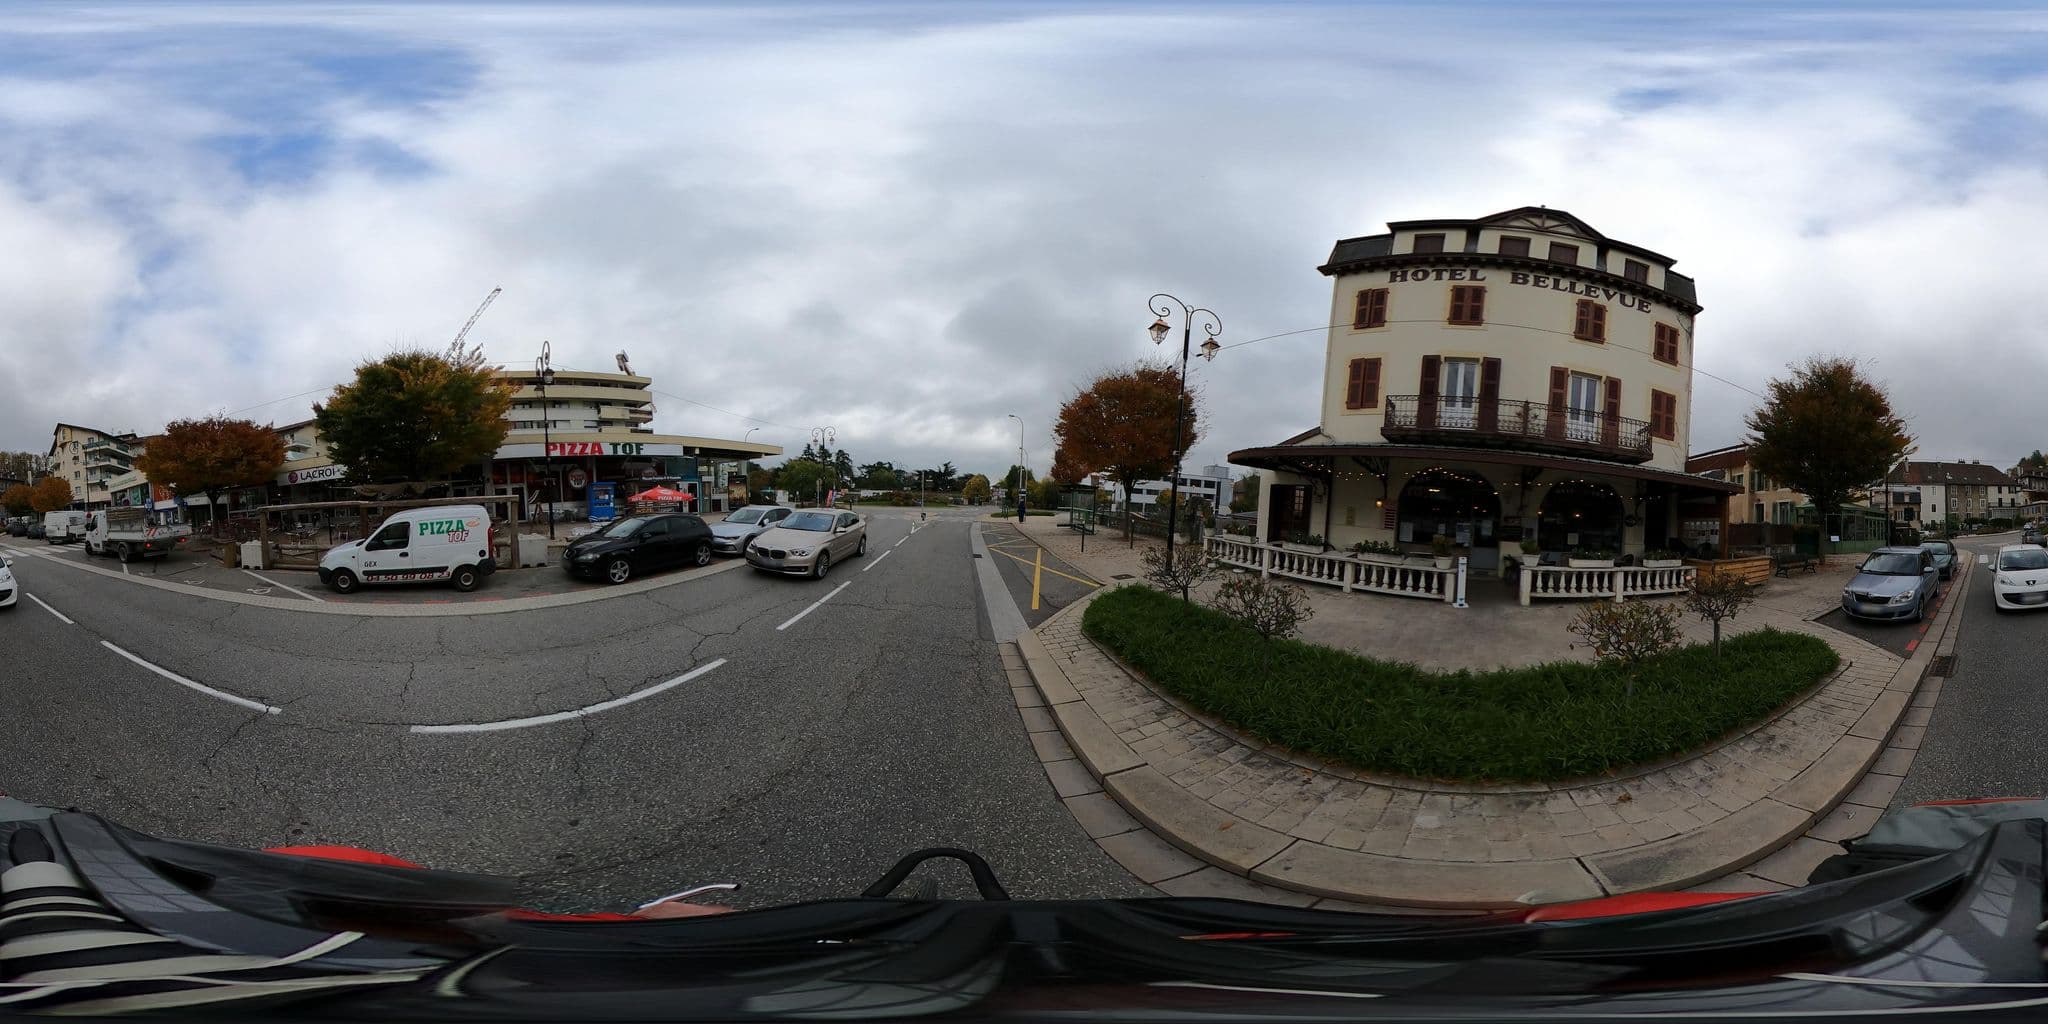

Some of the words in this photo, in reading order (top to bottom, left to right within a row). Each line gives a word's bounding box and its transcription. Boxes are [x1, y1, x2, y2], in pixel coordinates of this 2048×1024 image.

[1388, 268, 1486, 283] HOTEL
[1510, 273, 1652, 313] BELLEVUE
[547, 442, 604, 455] PIZZA
[609, 443, 644, 455] TOF
[300, 468, 340, 480] LACROI
[419, 519, 465, 536] PIZZA
[448, 530, 469, 543] TOF
